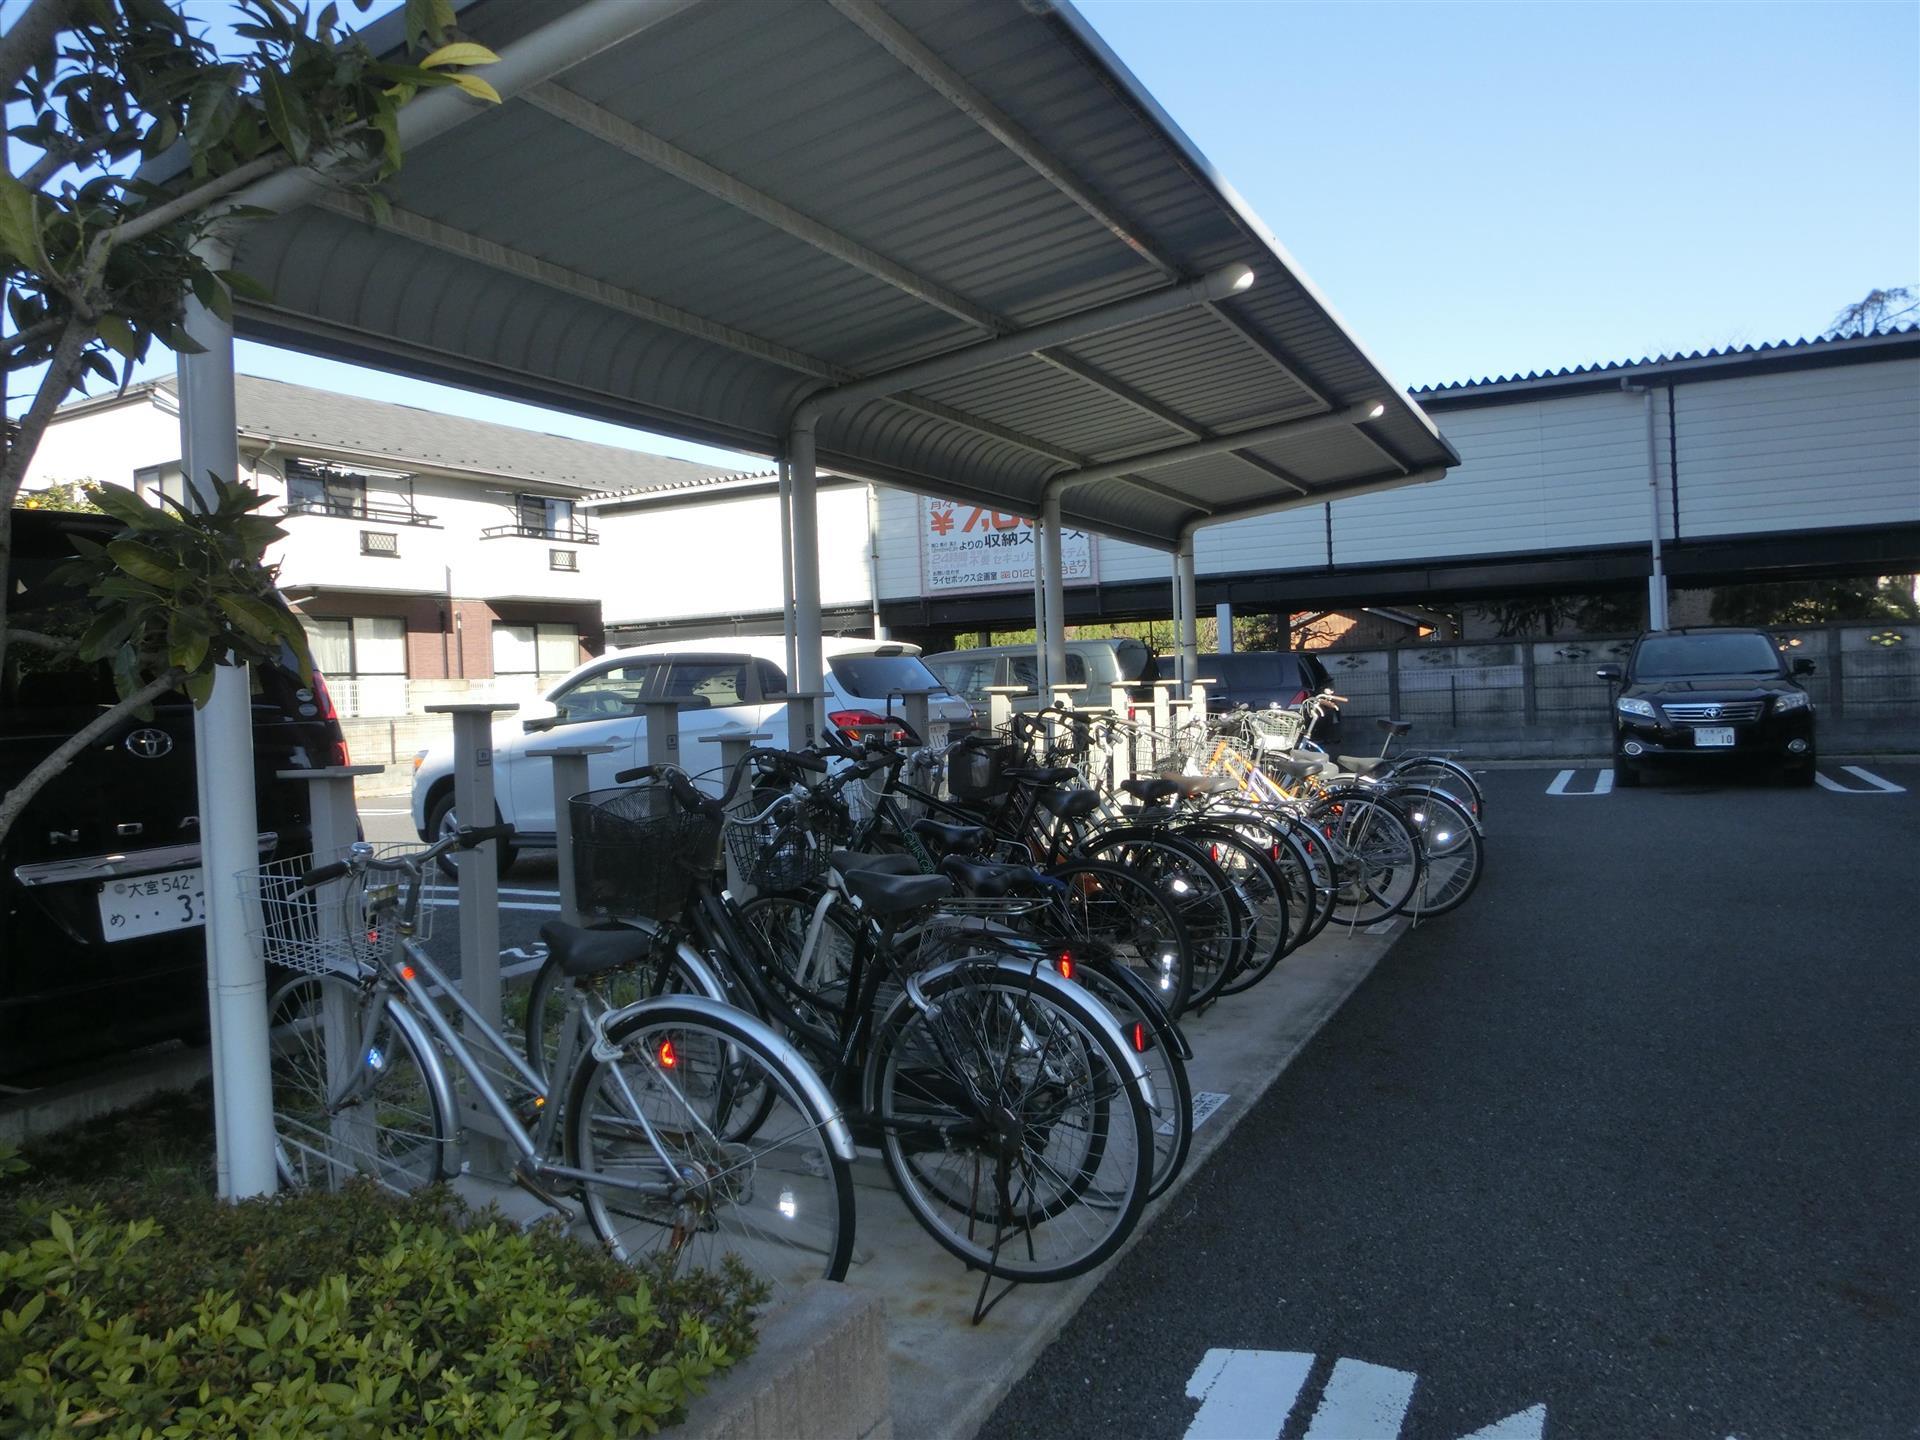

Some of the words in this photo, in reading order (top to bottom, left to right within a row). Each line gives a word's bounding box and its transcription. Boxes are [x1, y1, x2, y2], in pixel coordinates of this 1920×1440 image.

[960, 531, 1084, 551] よりの収納スース
[50, 815, 200, 844] NOA
